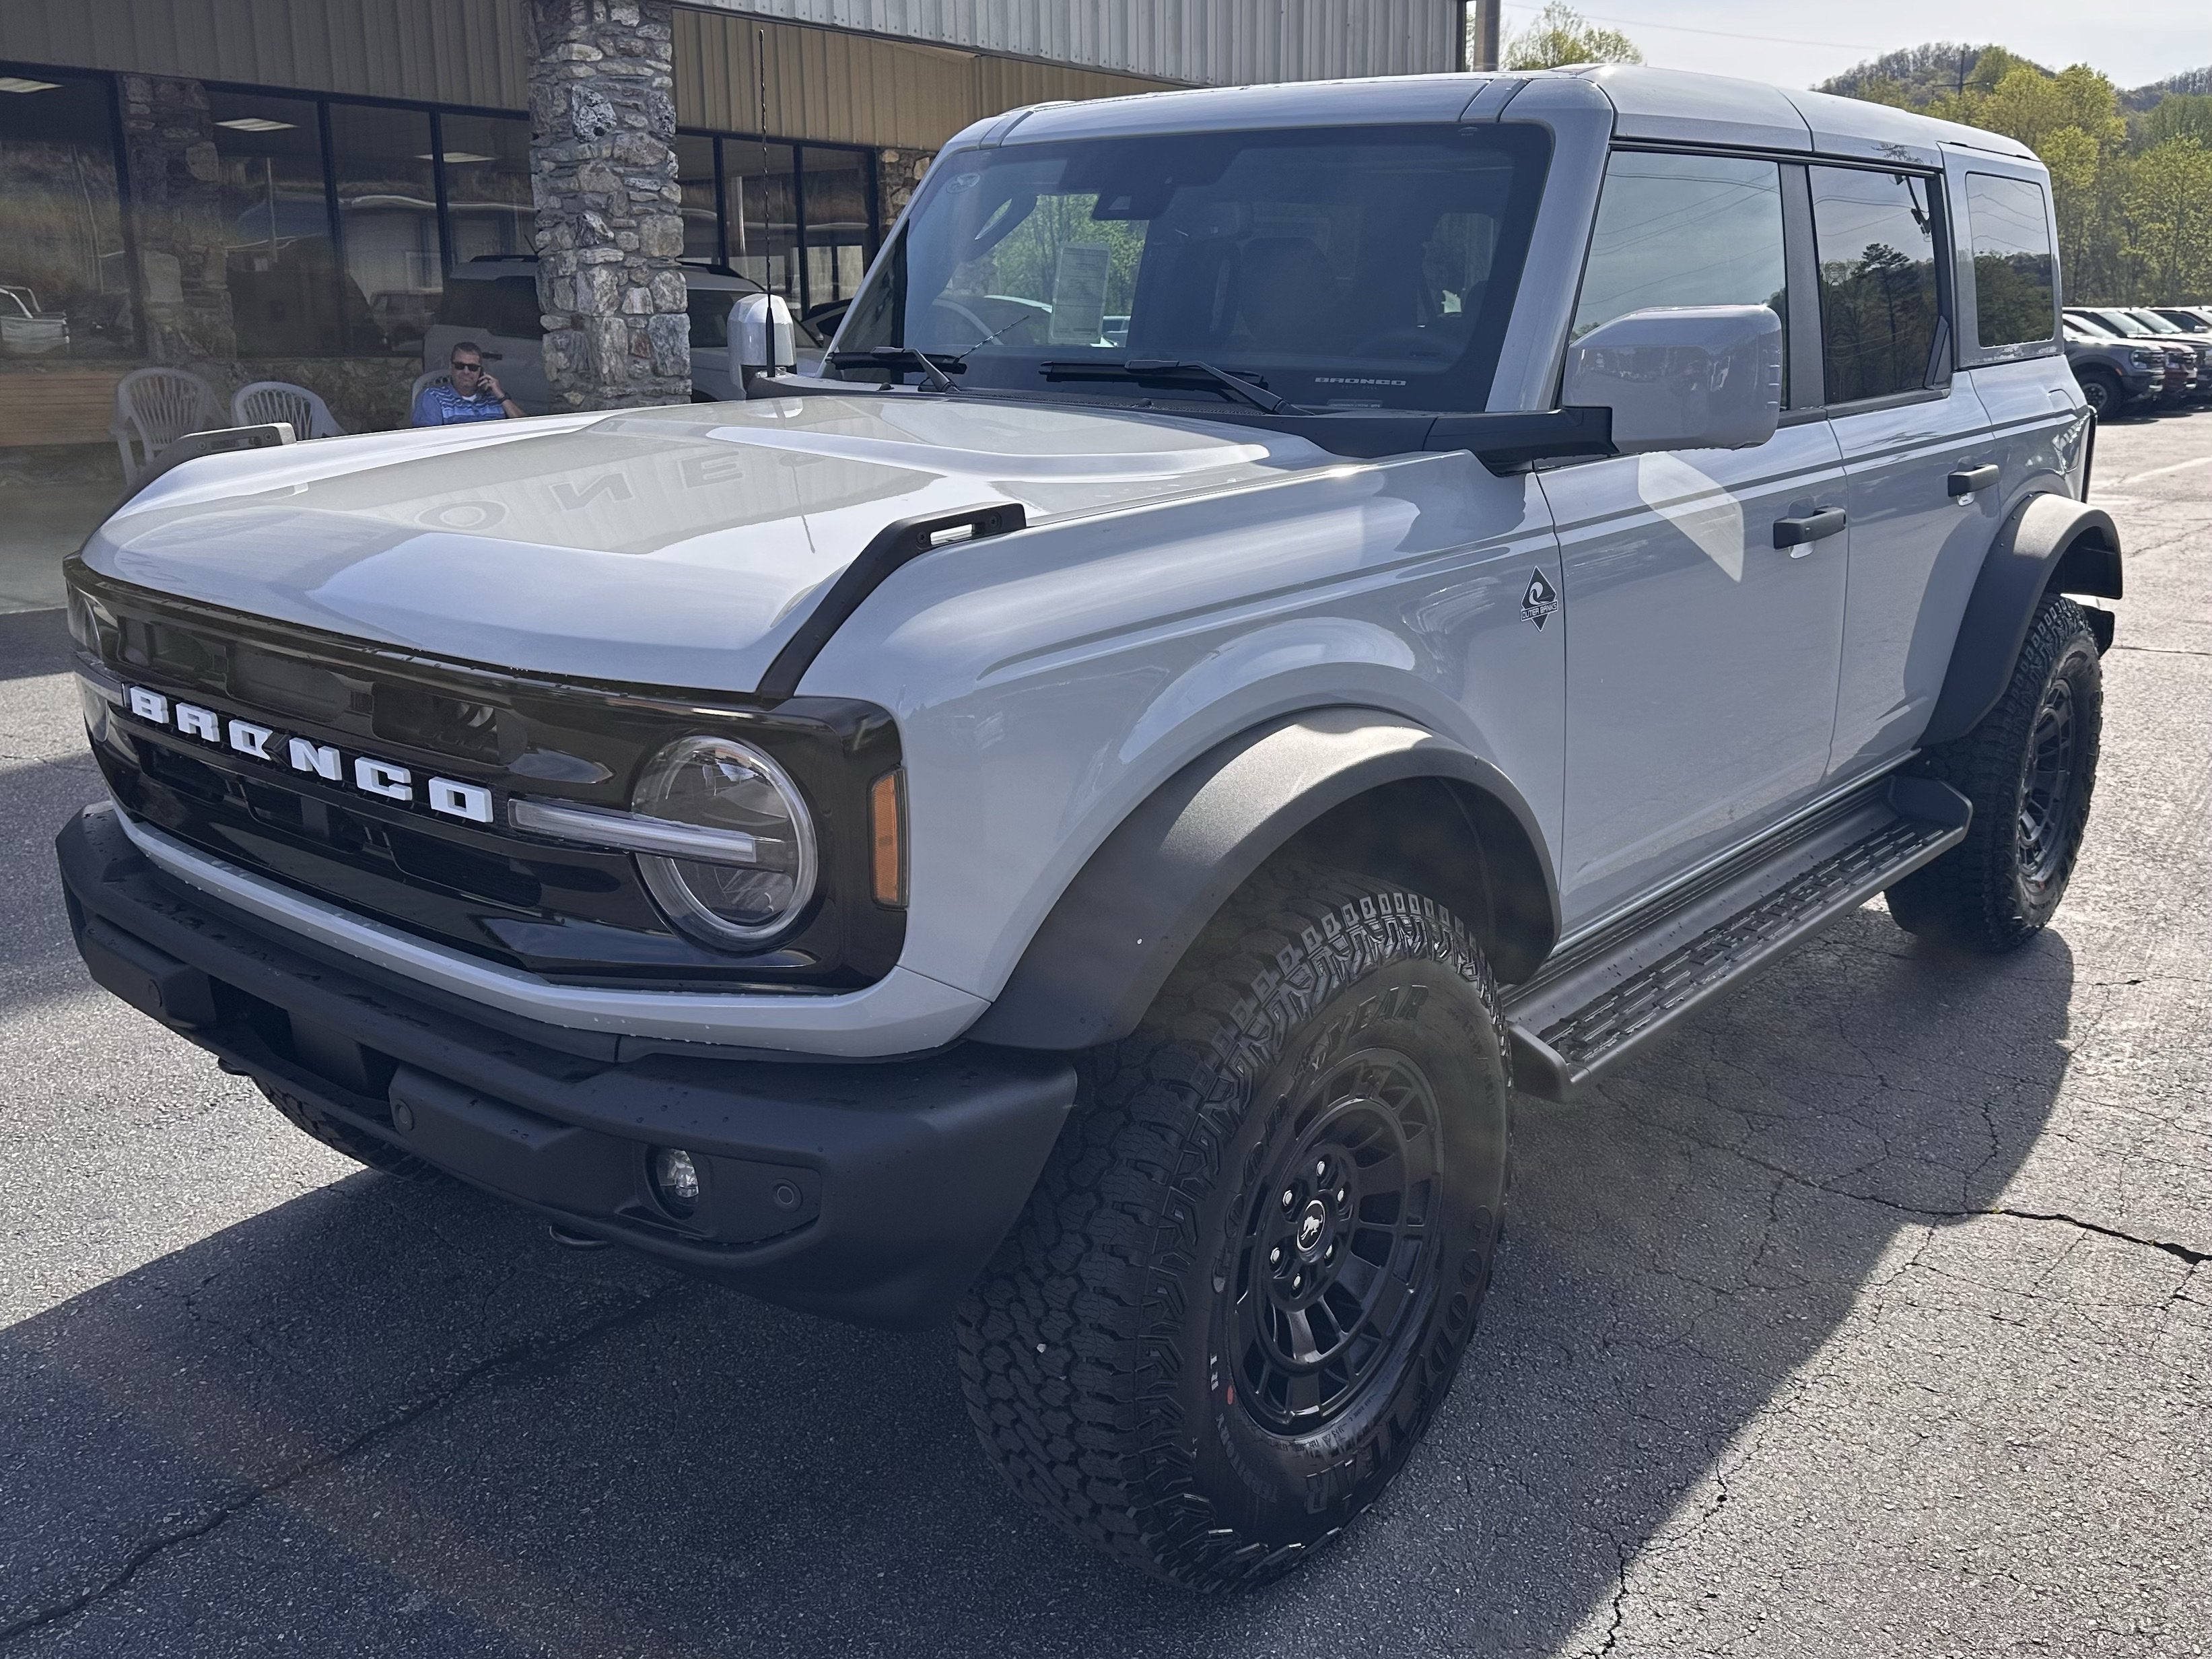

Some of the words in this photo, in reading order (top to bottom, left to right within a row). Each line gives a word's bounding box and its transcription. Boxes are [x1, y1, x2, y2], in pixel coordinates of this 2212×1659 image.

[1315, 376, 1406, 386] BRONCO
[1522, 607, 1540, 619] OUTER
[1540, 603, 1557, 614] BANKS
[129, 685, 494, 823] BRONCO
